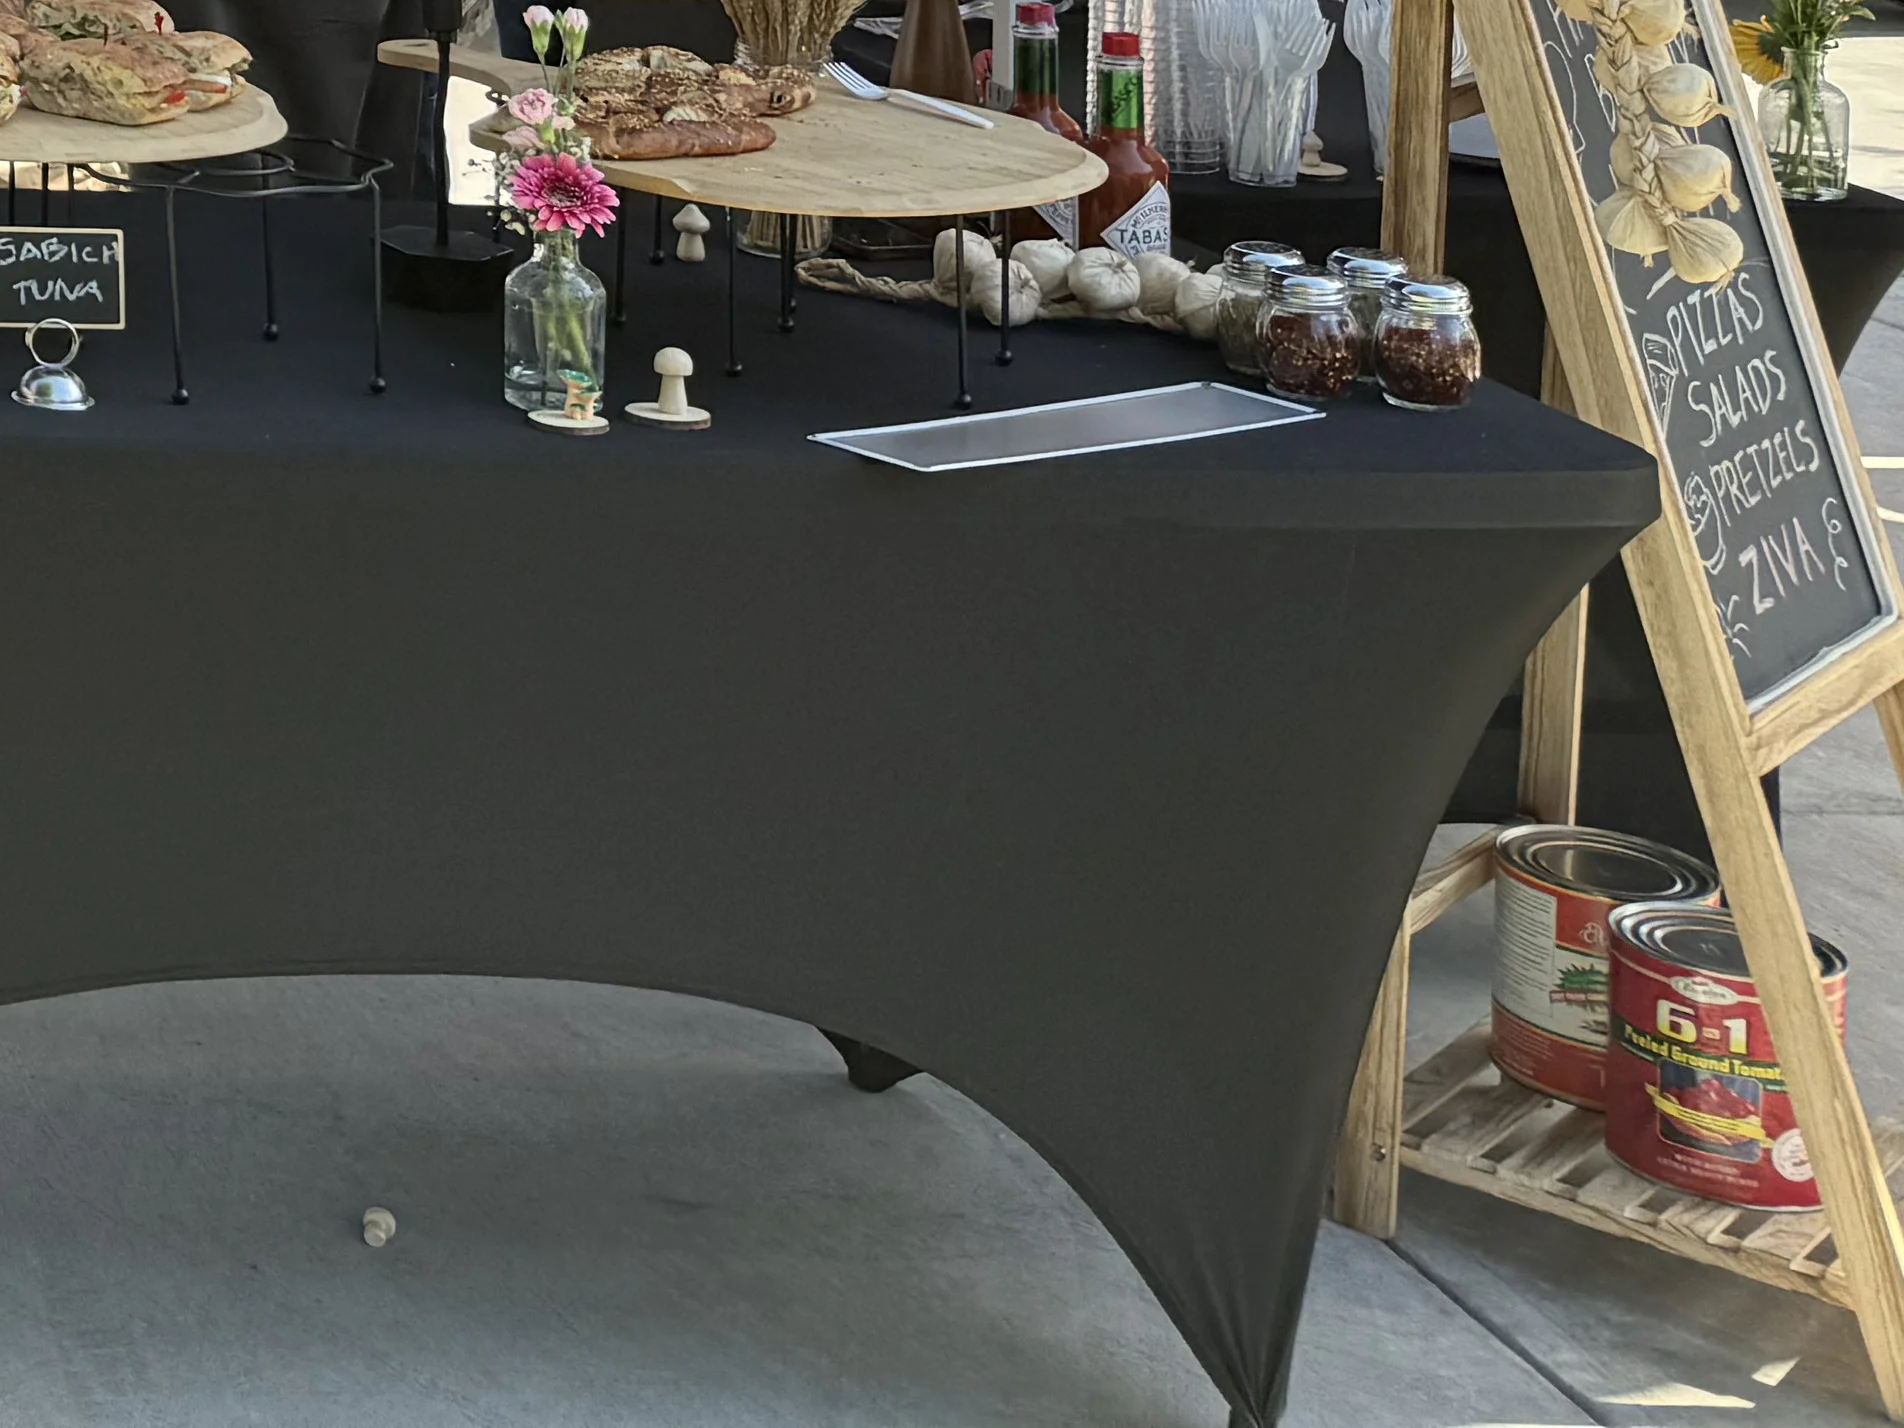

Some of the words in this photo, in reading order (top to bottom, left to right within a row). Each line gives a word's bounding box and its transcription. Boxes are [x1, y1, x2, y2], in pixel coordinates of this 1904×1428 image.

[1115, 226, 1168, 245] TABAS
[12, 277, 104, 306] TUNA
[1666, 272, 1764, 377] PIZZAS
[1687, 350, 1787, 448] SALADS
[1709, 419, 1820, 528] PRETZELS
[1738, 516, 1826, 615] ZIVA
[1624, 1024, 1669, 1058] Peeled
[1671, 1046, 1731, 1074] Ground
[1732, 1059, 1782, 1081] Tomat
